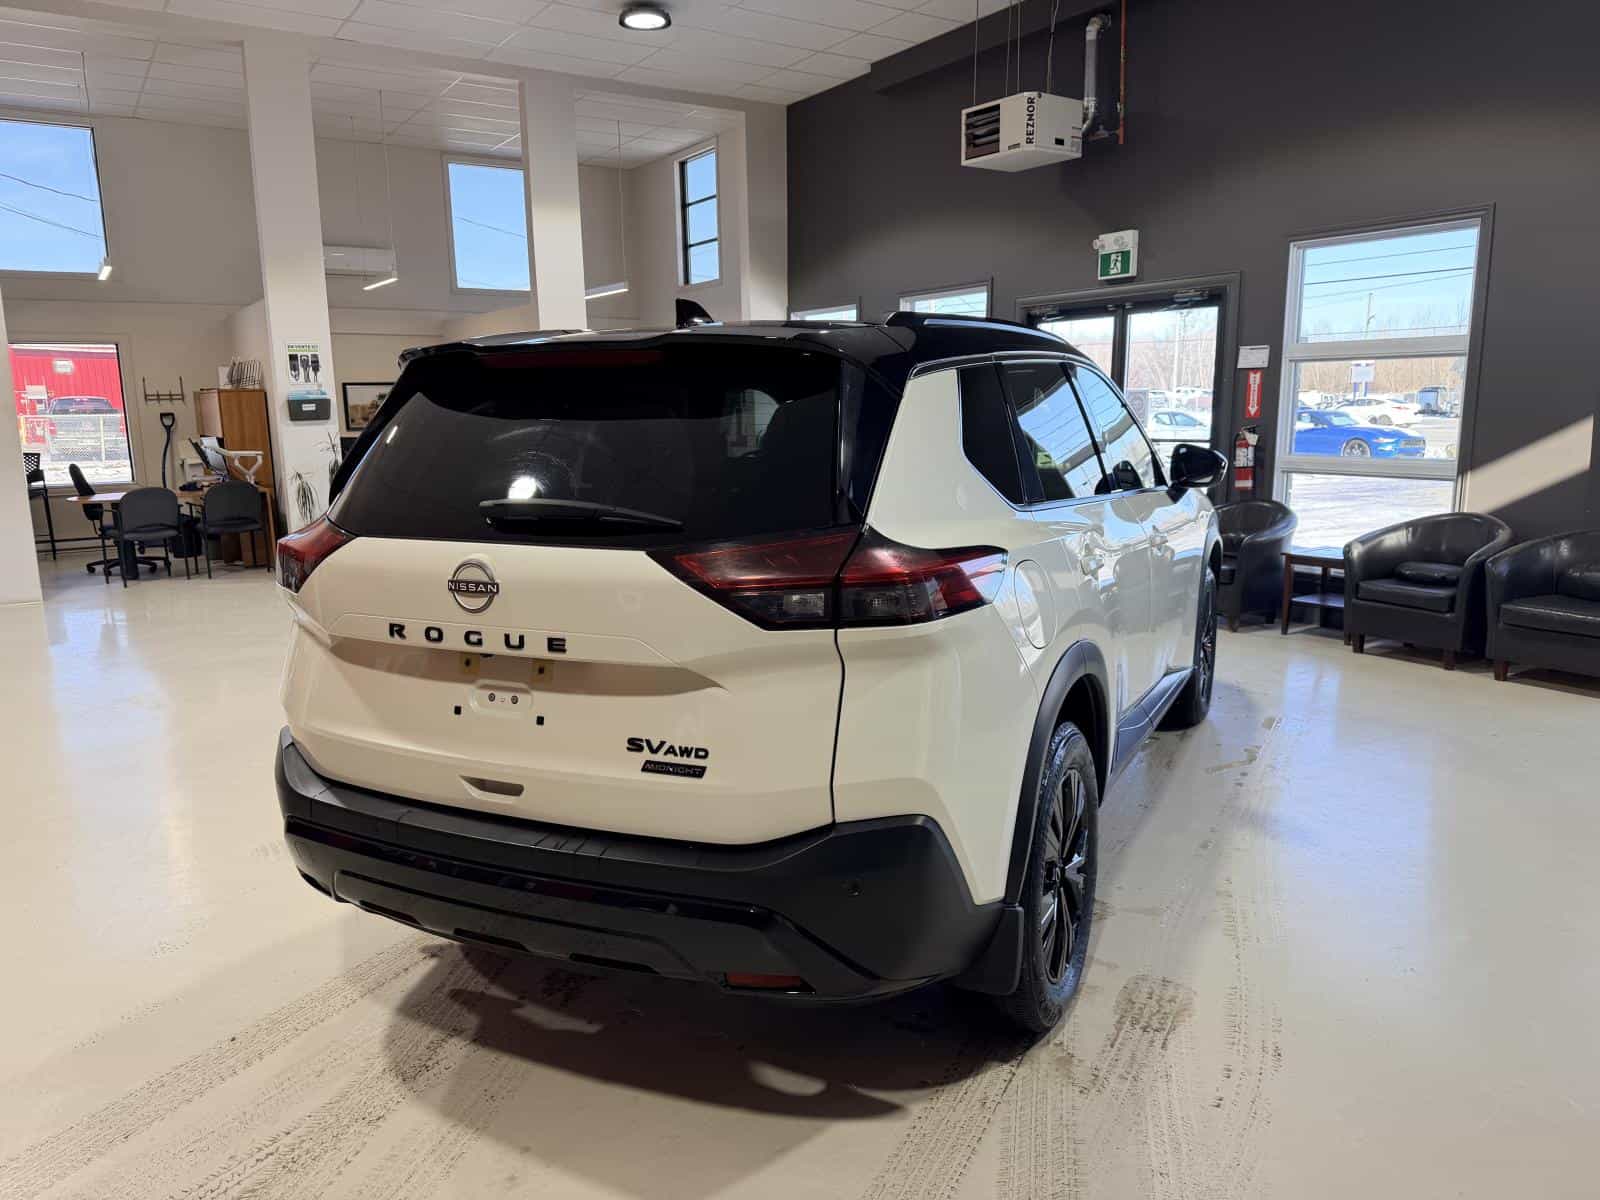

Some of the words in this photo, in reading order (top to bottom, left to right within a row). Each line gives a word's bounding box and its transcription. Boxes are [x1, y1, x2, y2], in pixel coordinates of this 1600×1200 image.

[1025, 96, 1036, 145] REZNOR
[448, 581, 498, 593] NISSAN
[388, 623, 567, 654] ROGUE
[643, 762, 704, 776] MIDNIGHT
